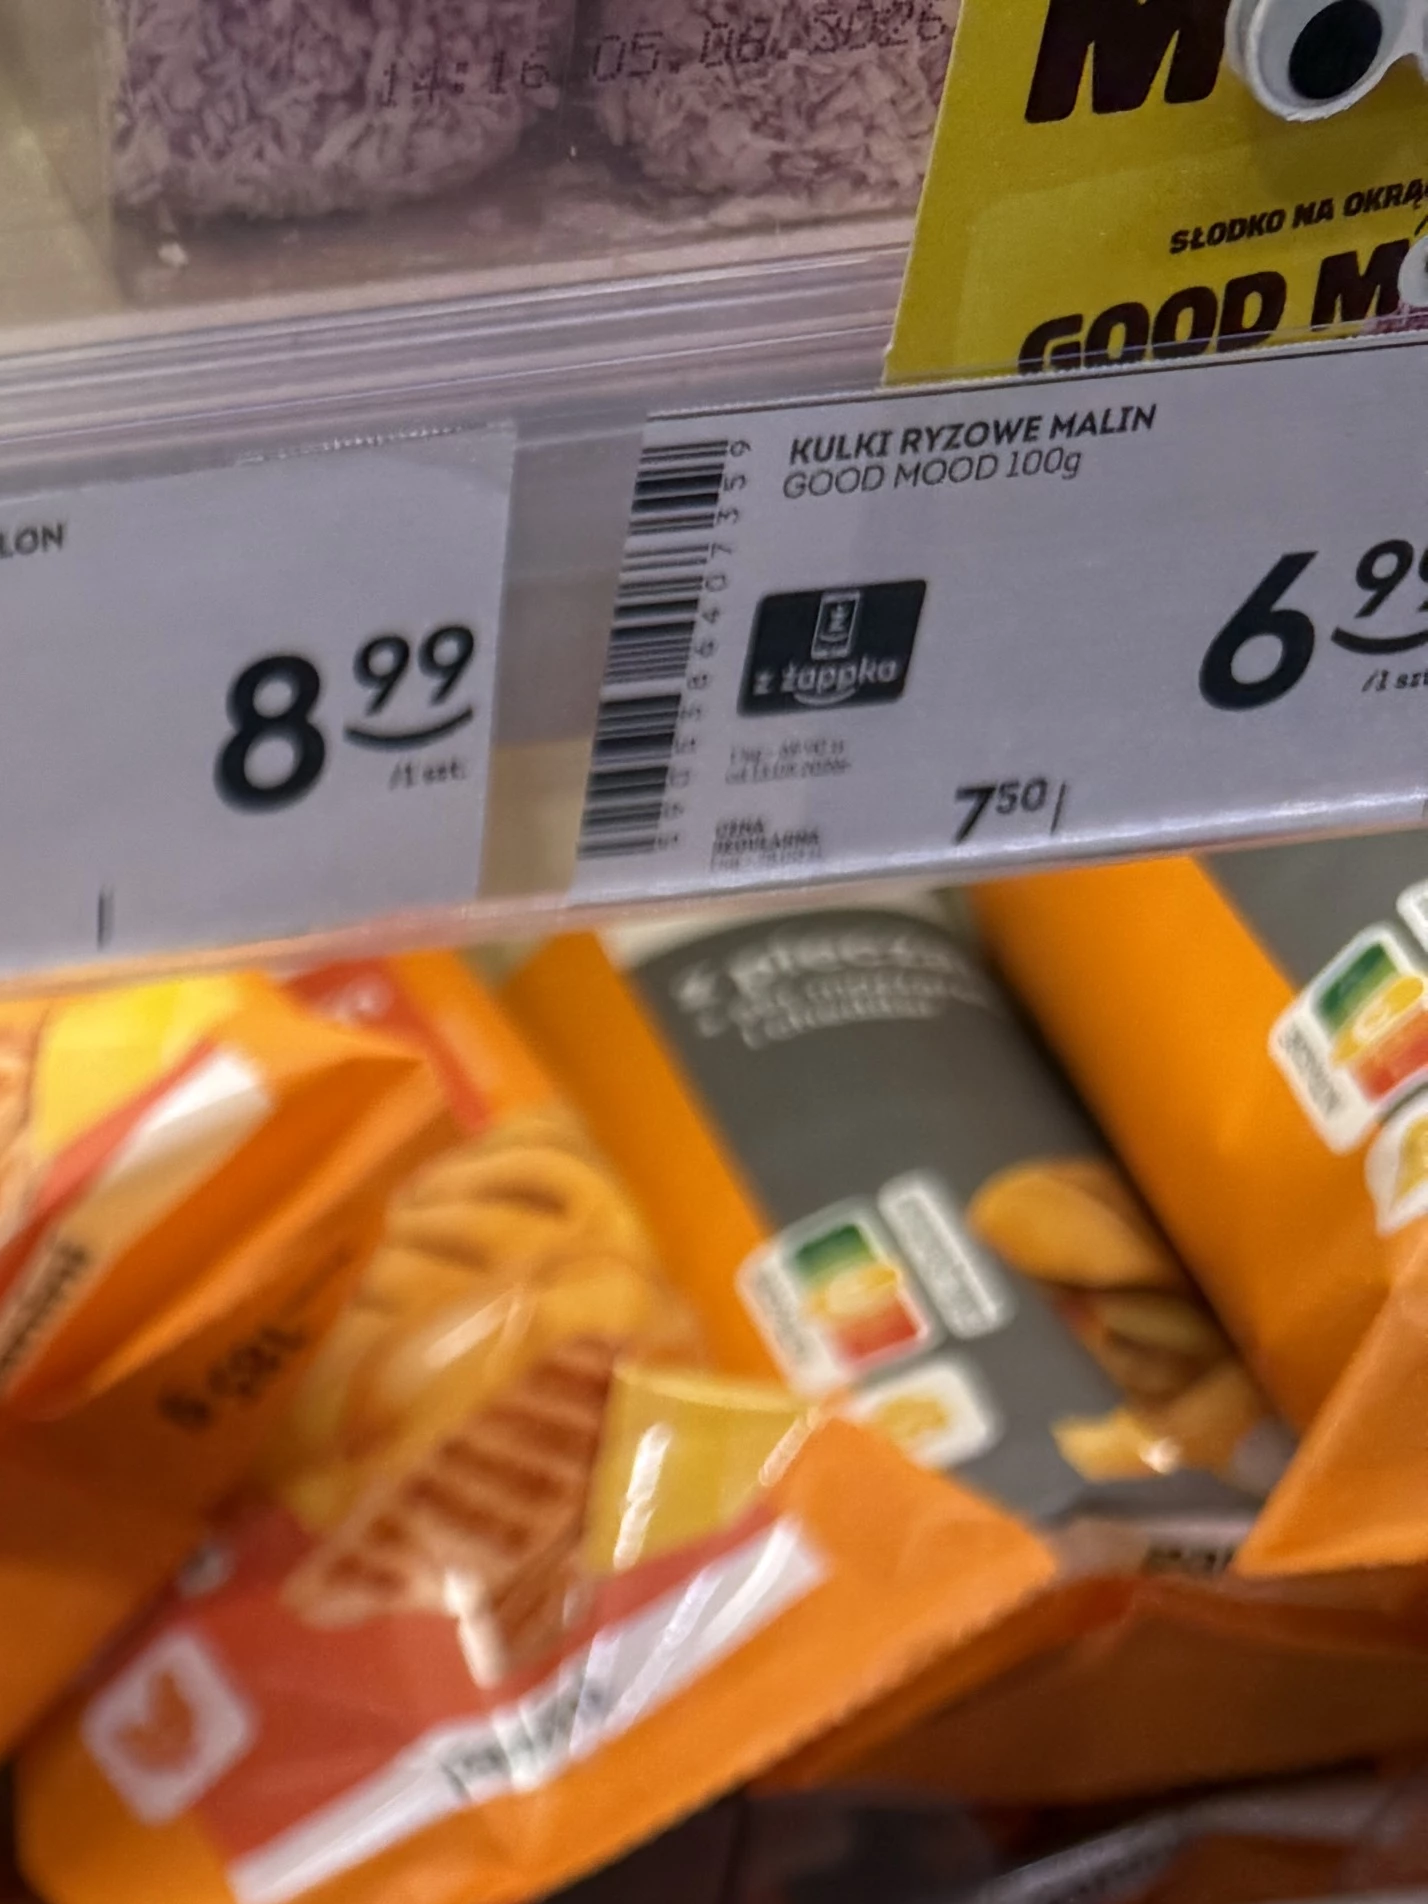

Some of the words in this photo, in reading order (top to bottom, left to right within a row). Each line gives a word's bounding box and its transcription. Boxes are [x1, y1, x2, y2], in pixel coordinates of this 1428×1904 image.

[1169, 209, 1284, 254] SŁODKO
[1293, 197, 1335, 229] NA
[1017, 270, 1287, 375] GOOD
[790, 427, 894, 466] KULKI
[900, 414, 1045, 458] RYZOWE
[1051, 402, 1157, 443] MALIN
[783, 464, 885, 500] GOOD
[893, 451, 1000, 489] MOOD
[1005, 444, 1083, 482] 100g
